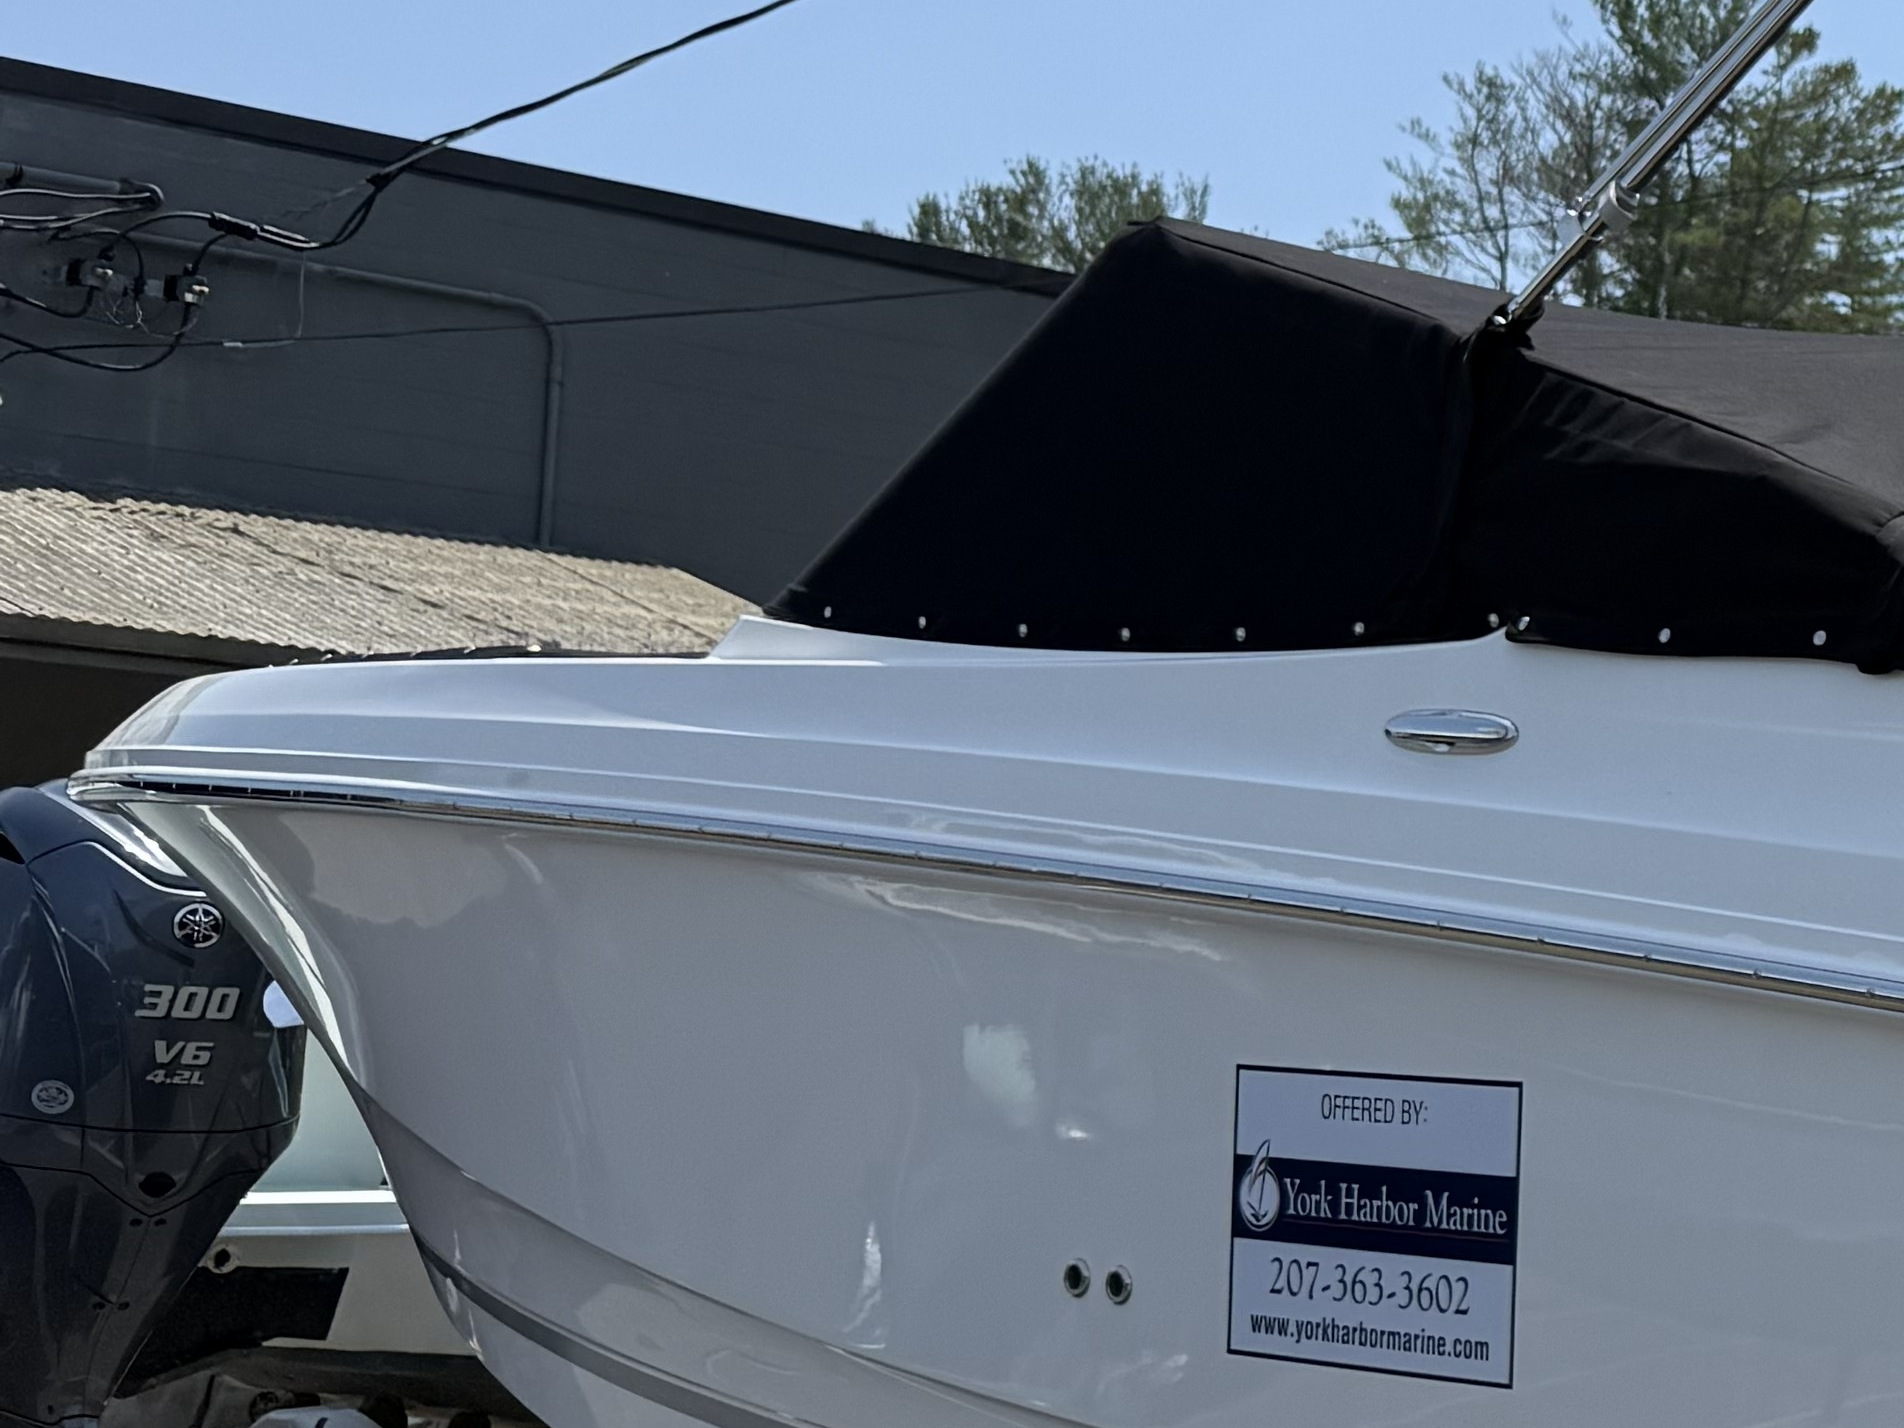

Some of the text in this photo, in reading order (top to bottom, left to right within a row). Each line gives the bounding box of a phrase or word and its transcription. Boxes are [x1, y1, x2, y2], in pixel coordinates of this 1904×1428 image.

[134, 983, 241, 1020] 300
[154, 1039, 214, 1066] V6
[145, 1069, 205, 1086] 4.2L
[1321, 1093, 1429, 1125] OFFERED BY:
[1282, 1177, 1508, 1235] York Harbor Marine
[1268, 1257, 1471, 1316] 207-363-3602
[1250, 1313, 1490, 1362] www.yorkharbormarine.com
